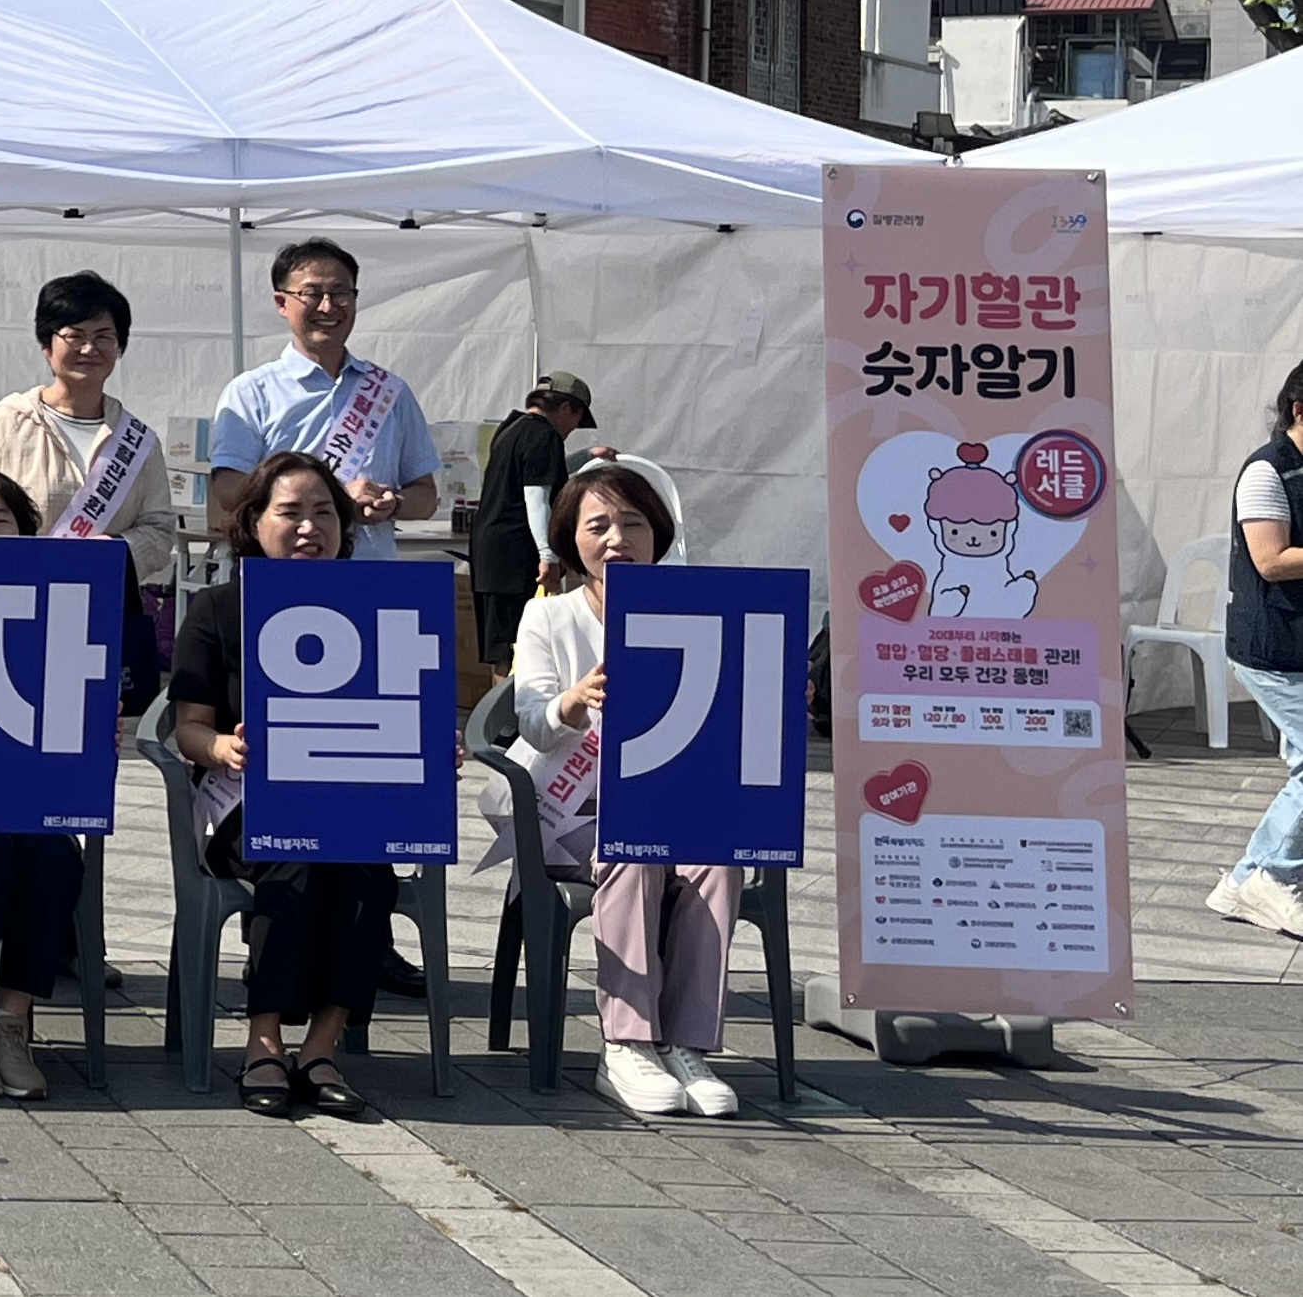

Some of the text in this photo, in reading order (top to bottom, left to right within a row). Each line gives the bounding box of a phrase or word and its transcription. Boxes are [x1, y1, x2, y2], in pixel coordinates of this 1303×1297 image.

[863, 272, 1081, 330] 자기혈관
[862, 341, 1076, 399] 숫자알기
[1036, 449, 1086, 473] 레드
[1037, 474, 1086, 499] 서클
[903, 665, 933, 682] 우리
[939, 667, 969, 683] 모두
[975, 667, 1007, 684] 건강
[1044, 648, 1080, 665] 관리!
[258, 605, 440, 784] 알
[620, 613, 785, 786] 기
